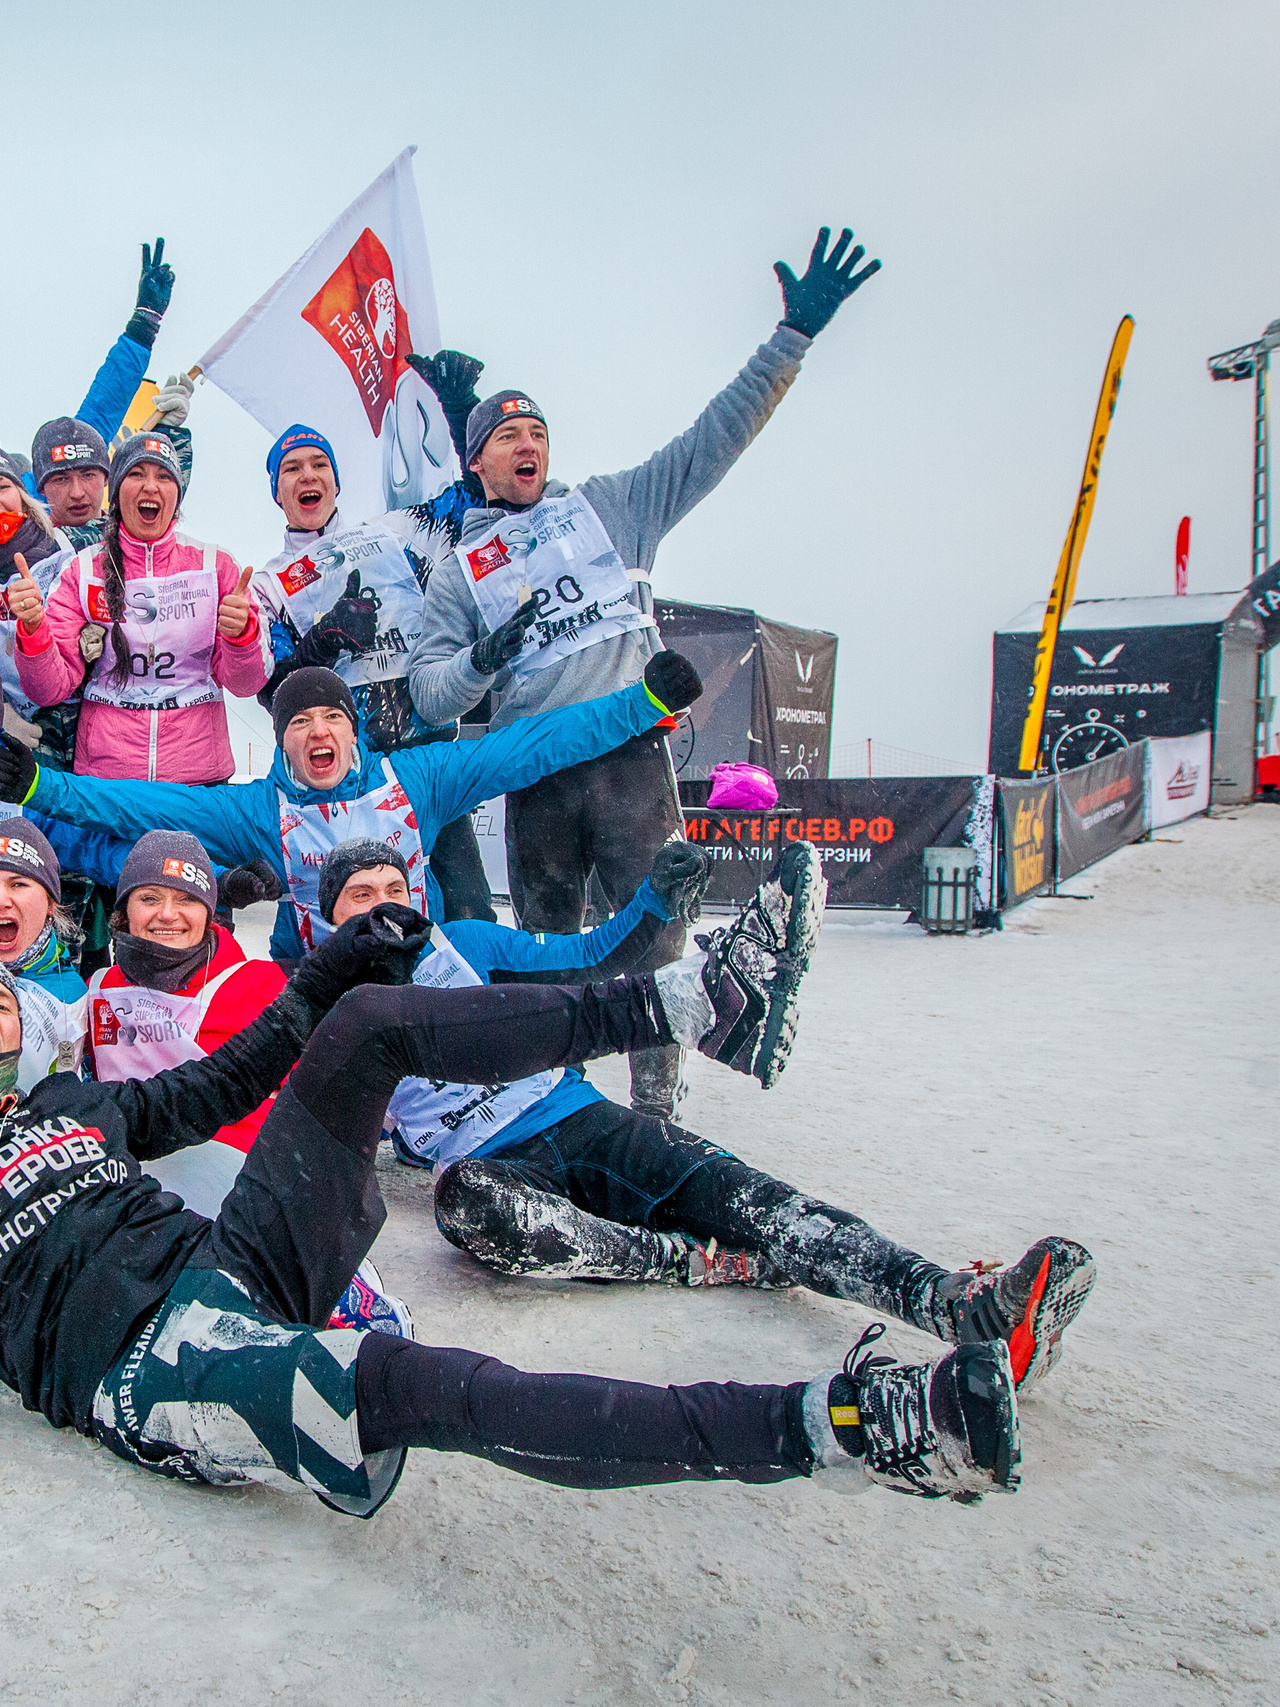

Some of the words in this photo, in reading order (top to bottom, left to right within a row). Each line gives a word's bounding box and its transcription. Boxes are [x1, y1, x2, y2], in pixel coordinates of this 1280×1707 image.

[348, 311, 384, 384] SIBERIAN
[329, 313, 381, 406] HEALTH
[530, 504, 559, 526] SIBERIAN
[537, 518, 577, 546] SPORT
[345, 541, 384, 563] SPORT
[479, 559, 505, 575] HEALTH
[157, 579, 189, 594] SIBERIAN
[290, 573, 315, 591] HEALTH
[158, 592, 180, 605] SUPER
[180, 588, 210, 601] NATURAL
[532, 574, 585, 620] 20
[159, 602, 196, 623] SPORT
[129, 652, 176, 679] 02
[1028, 682, 1171, 698] ОНОМЕТРАЖ
[684, 816, 896, 844] ИГАГЕРОЕВ.РФ
[31, 986, 60, 1021] SIBERIAN
[136, 1020, 182, 1044] SPORT
[835, 1409, 859, 1418] Reeb
